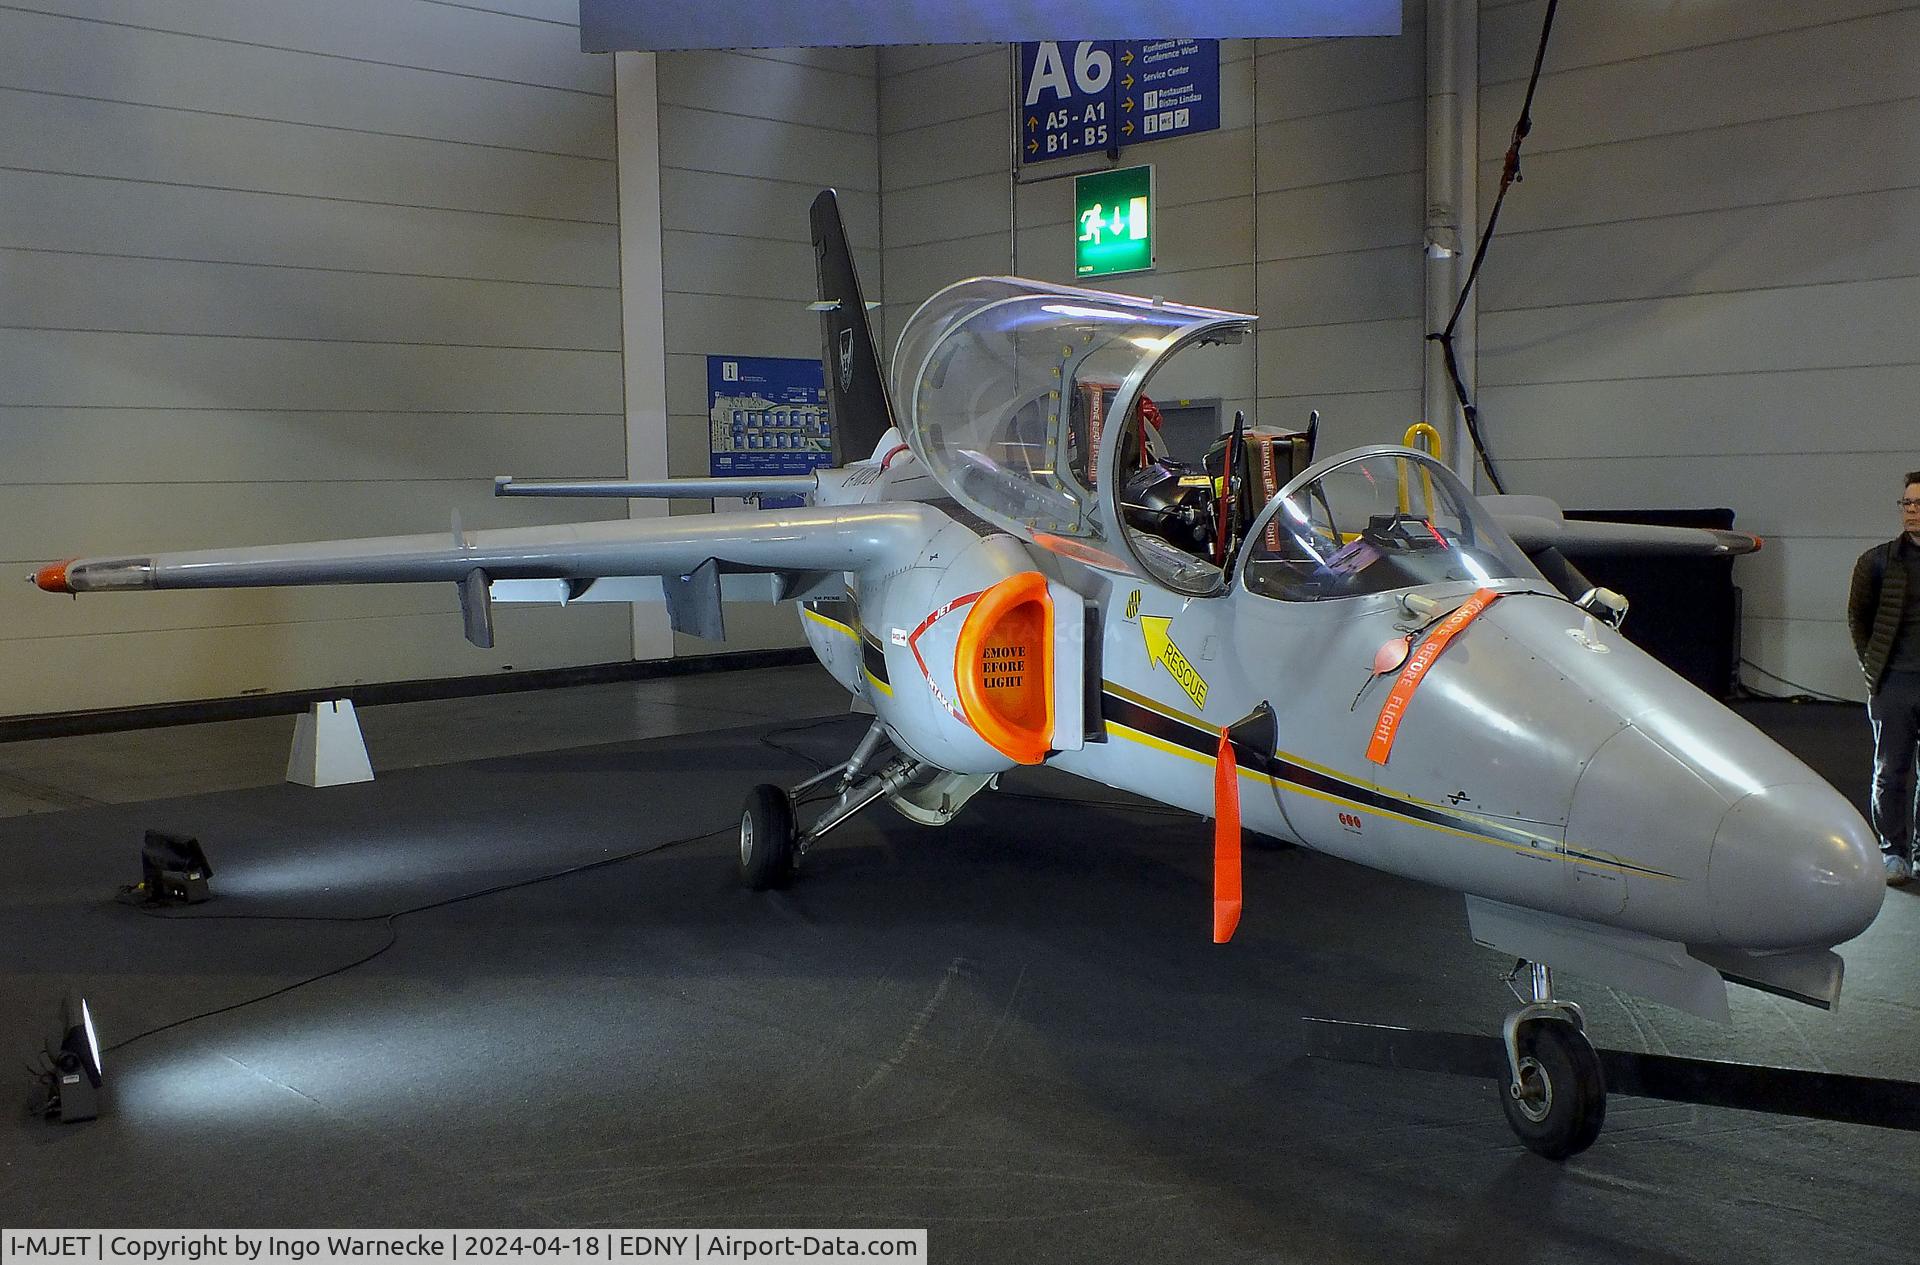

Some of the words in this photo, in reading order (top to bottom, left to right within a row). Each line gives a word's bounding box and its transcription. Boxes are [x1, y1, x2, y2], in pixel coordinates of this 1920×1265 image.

[1143, 51, 1180, 64] Conference
[1181, 45, 1199, 56] West
[1025, 41, 1112, 106] A6
[1143, 70, 1167, 83] Service
[1167, 65, 1190, 77] Center
[1159, 83, 1194, 98] Restaurant
[1159, 98, 1178, 109] Bistro
[1179, 93, 1202, 104] Lindau
[1046, 108, 1068, 130] A5
[1083, 102, 1105, 124] A1
[1047, 133, 1068, 153] B1
[1084, 125, 1108, 146] B5
[1261, 440, 1272, 477] REMOVE
[934, 601, 953, 620] JET
[1438, 598, 1485, 636] REMOVE
[982, 646, 1026, 659] EMOVE
[982, 660, 1025, 673] EFORE
[1164, 642, 1206, 706] RESCUE
[1400, 642, 1439, 688] BEFORE
[983, 675, 1023, 688] LIGHT
[1375, 695, 1404, 745] FLIGHT
